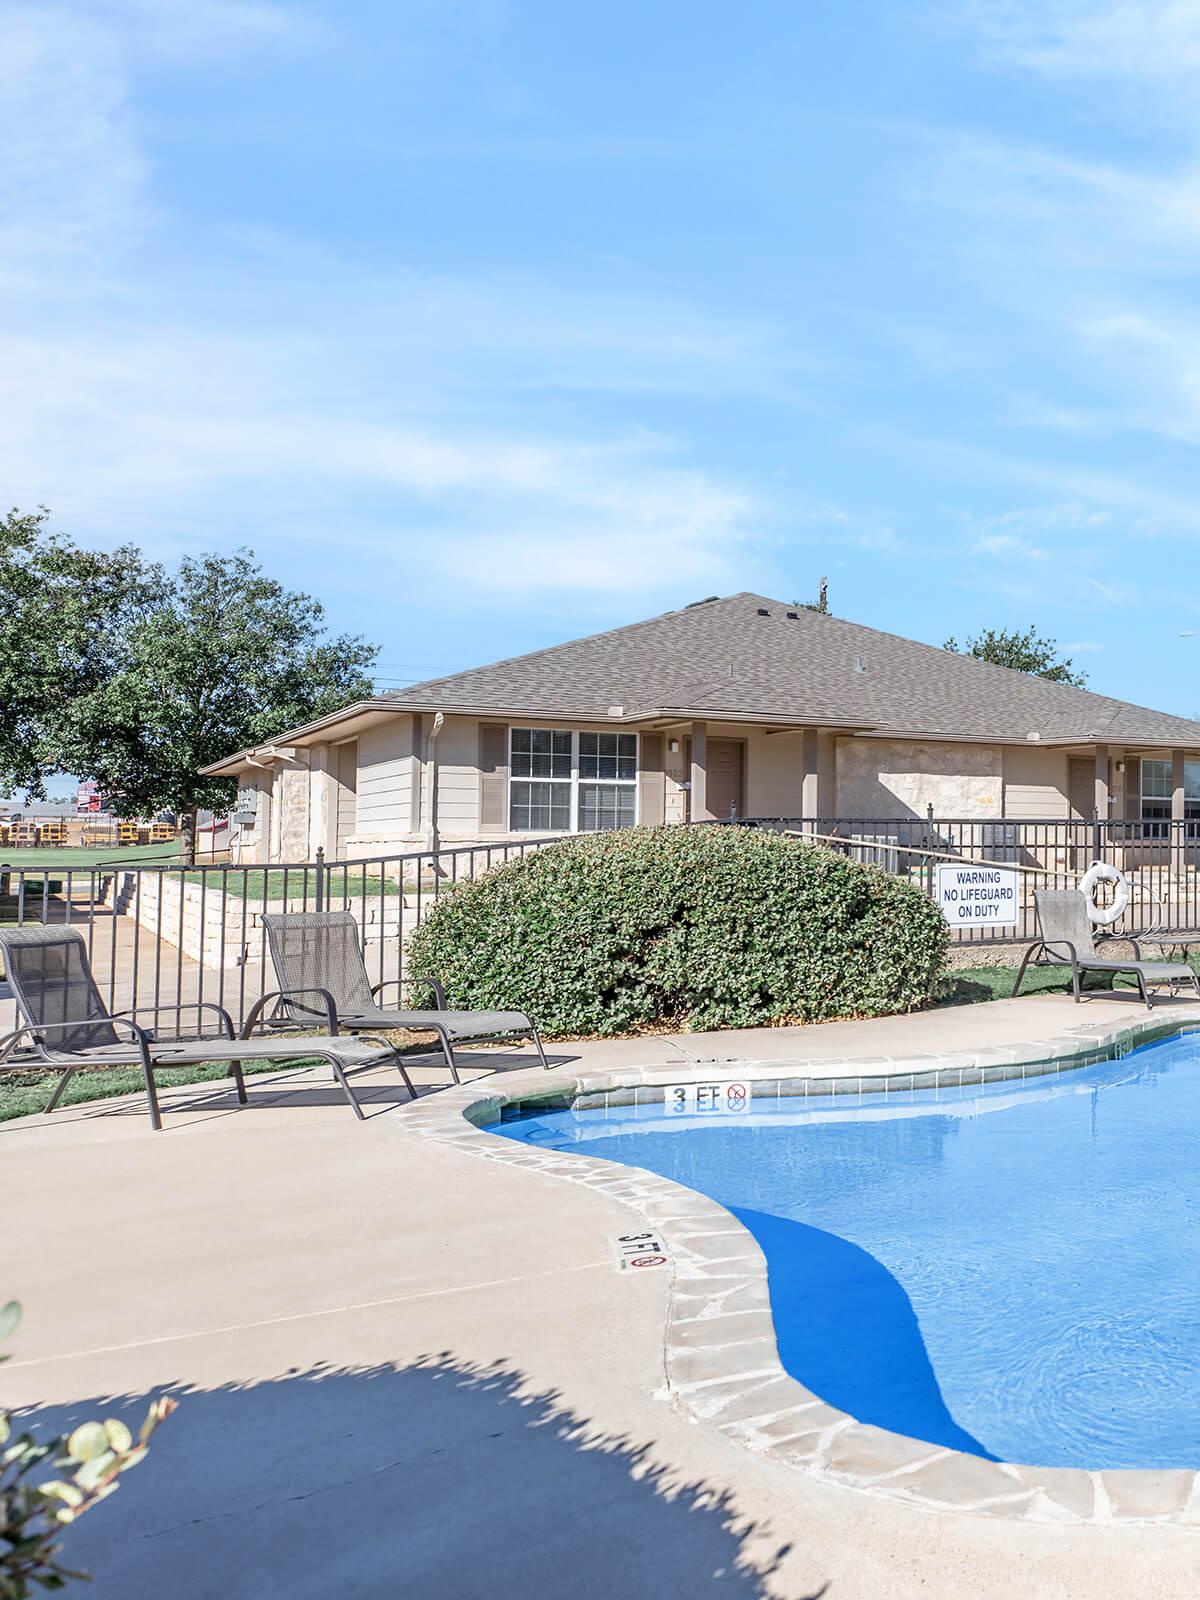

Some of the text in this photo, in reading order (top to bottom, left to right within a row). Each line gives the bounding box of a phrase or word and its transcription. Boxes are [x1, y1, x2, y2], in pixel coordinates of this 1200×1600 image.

[957, 871, 1001, 884] WARNING
[944, 888, 1013, 901] NO LIFEGUARD
[959, 905, 1000, 918] ON DUTY
[618, 1233, 661, 1255] 3 FT
